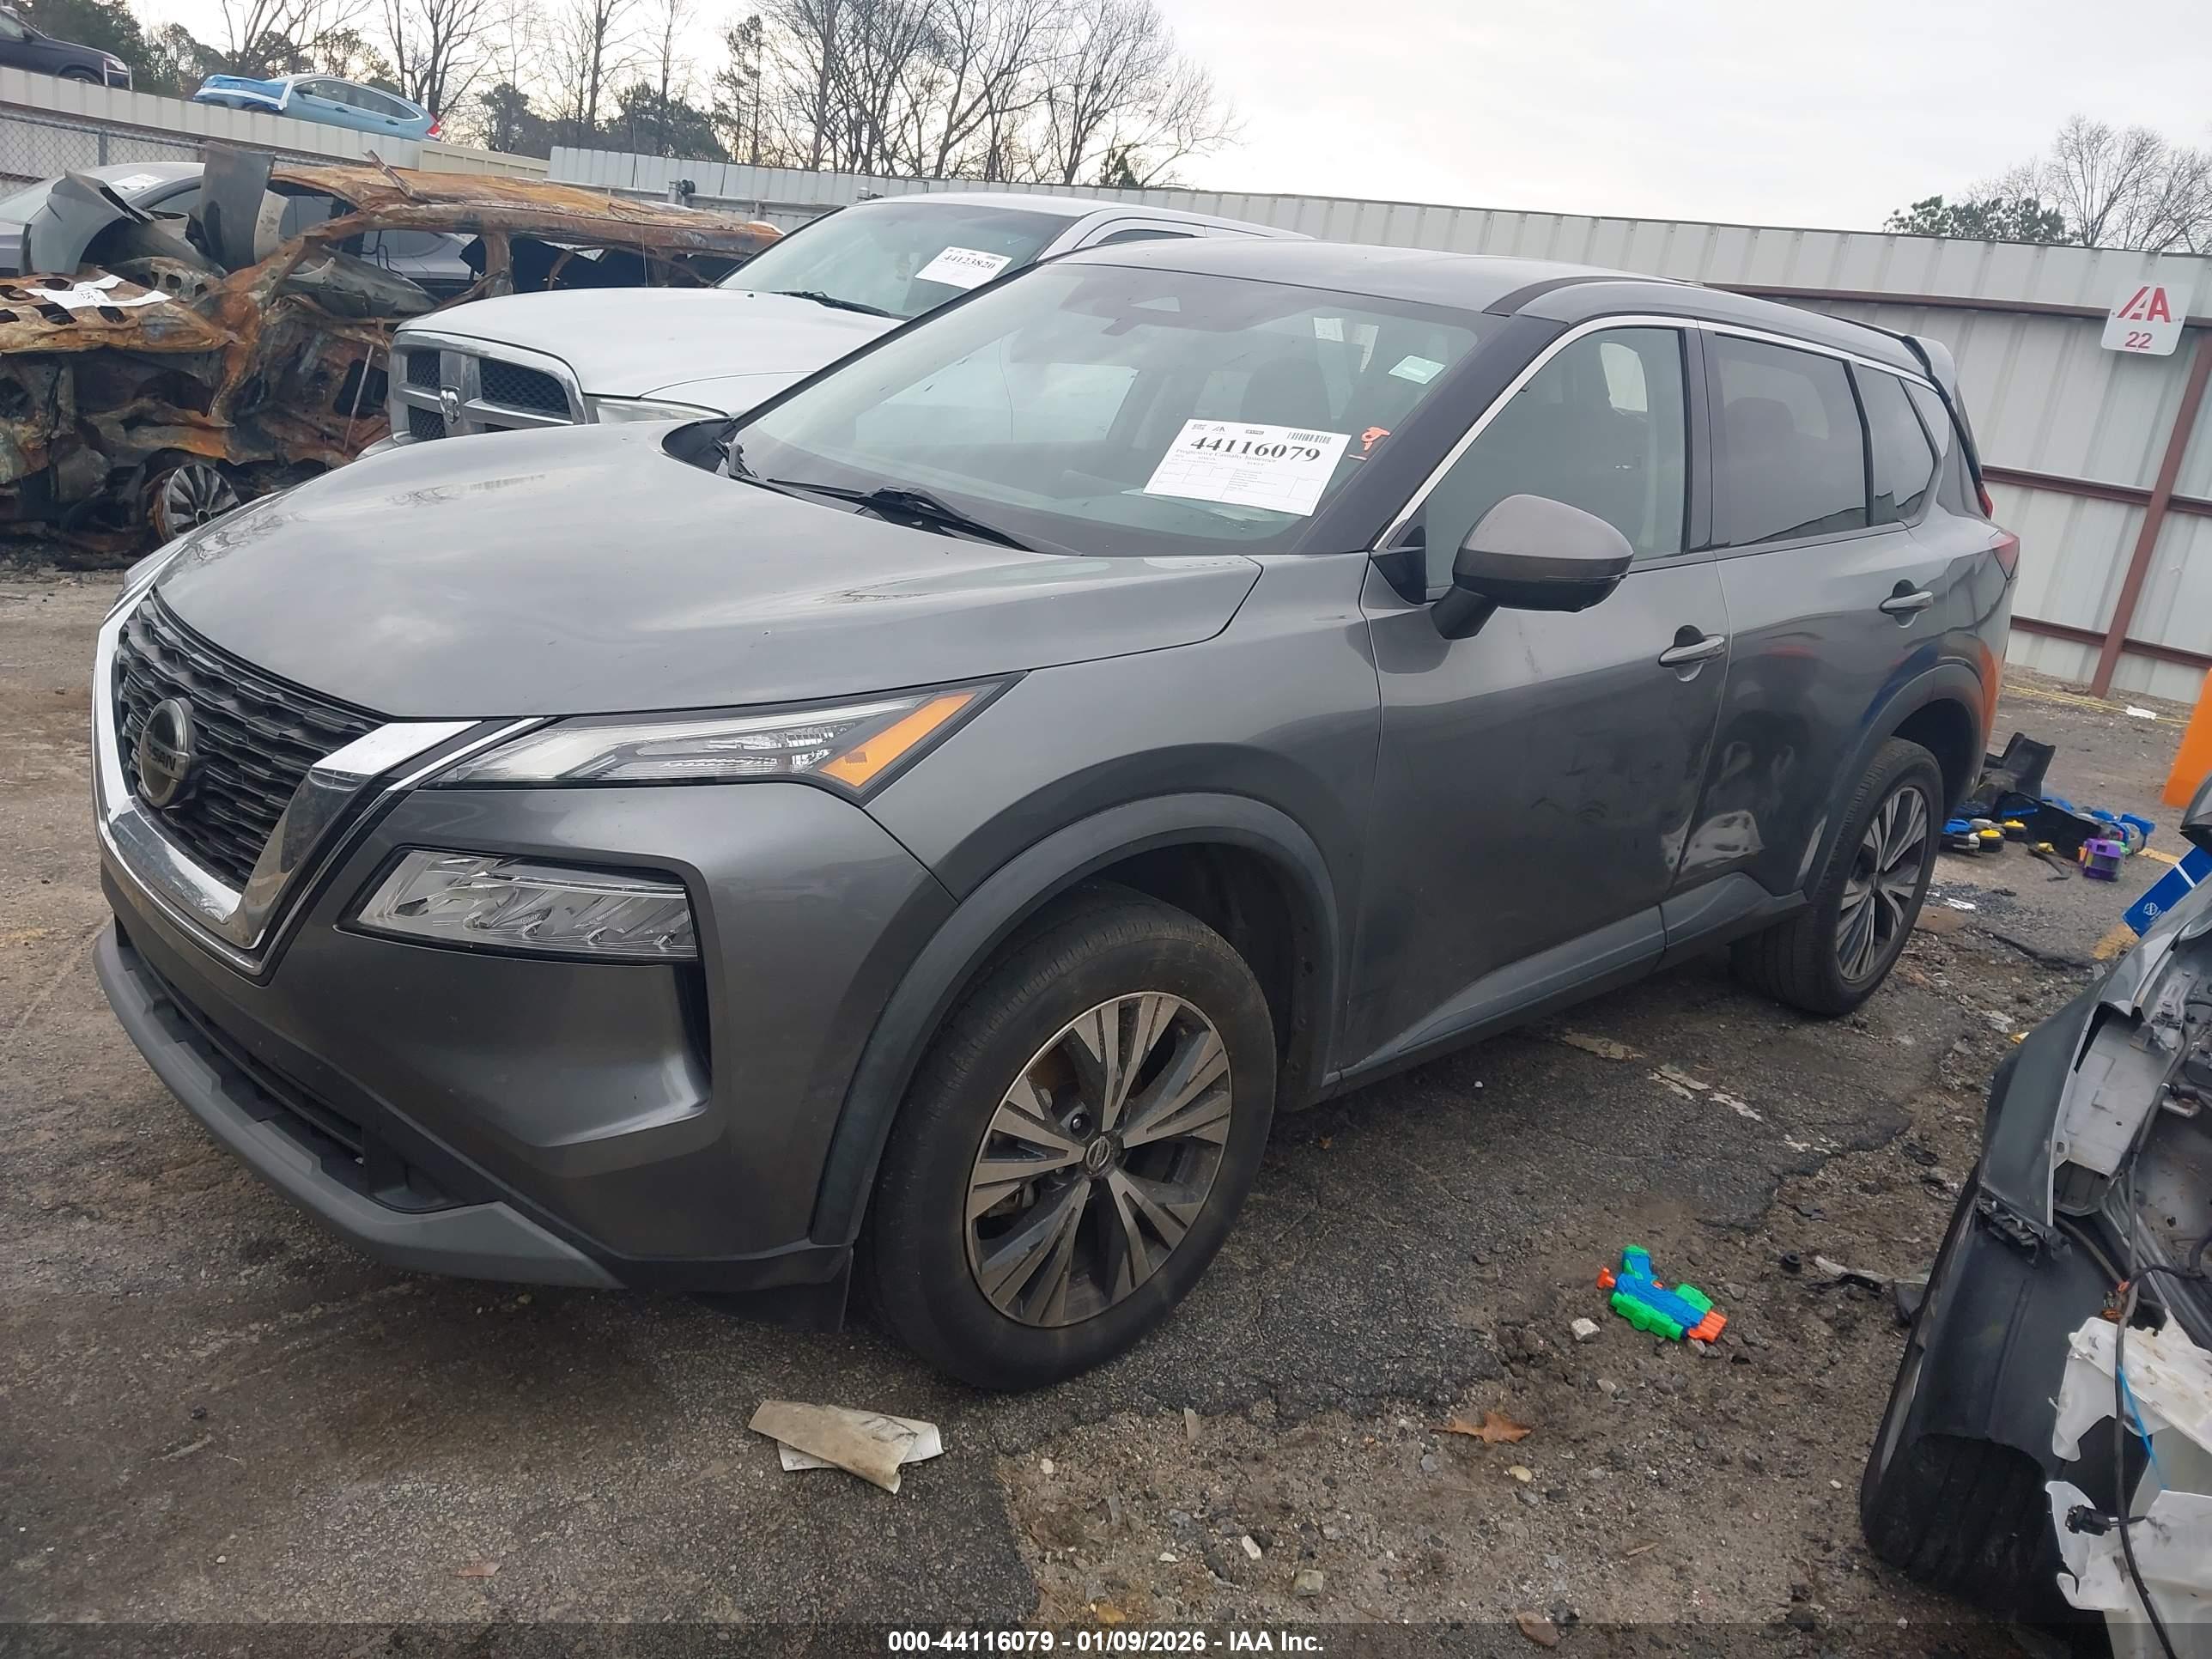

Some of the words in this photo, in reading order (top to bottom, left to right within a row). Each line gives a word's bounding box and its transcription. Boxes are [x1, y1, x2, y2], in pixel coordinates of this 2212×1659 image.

[944, 254, 996, 270] 44123820
[2124, 331, 2153, 349] 22
[1190, 436, 1321, 462] 44116079
